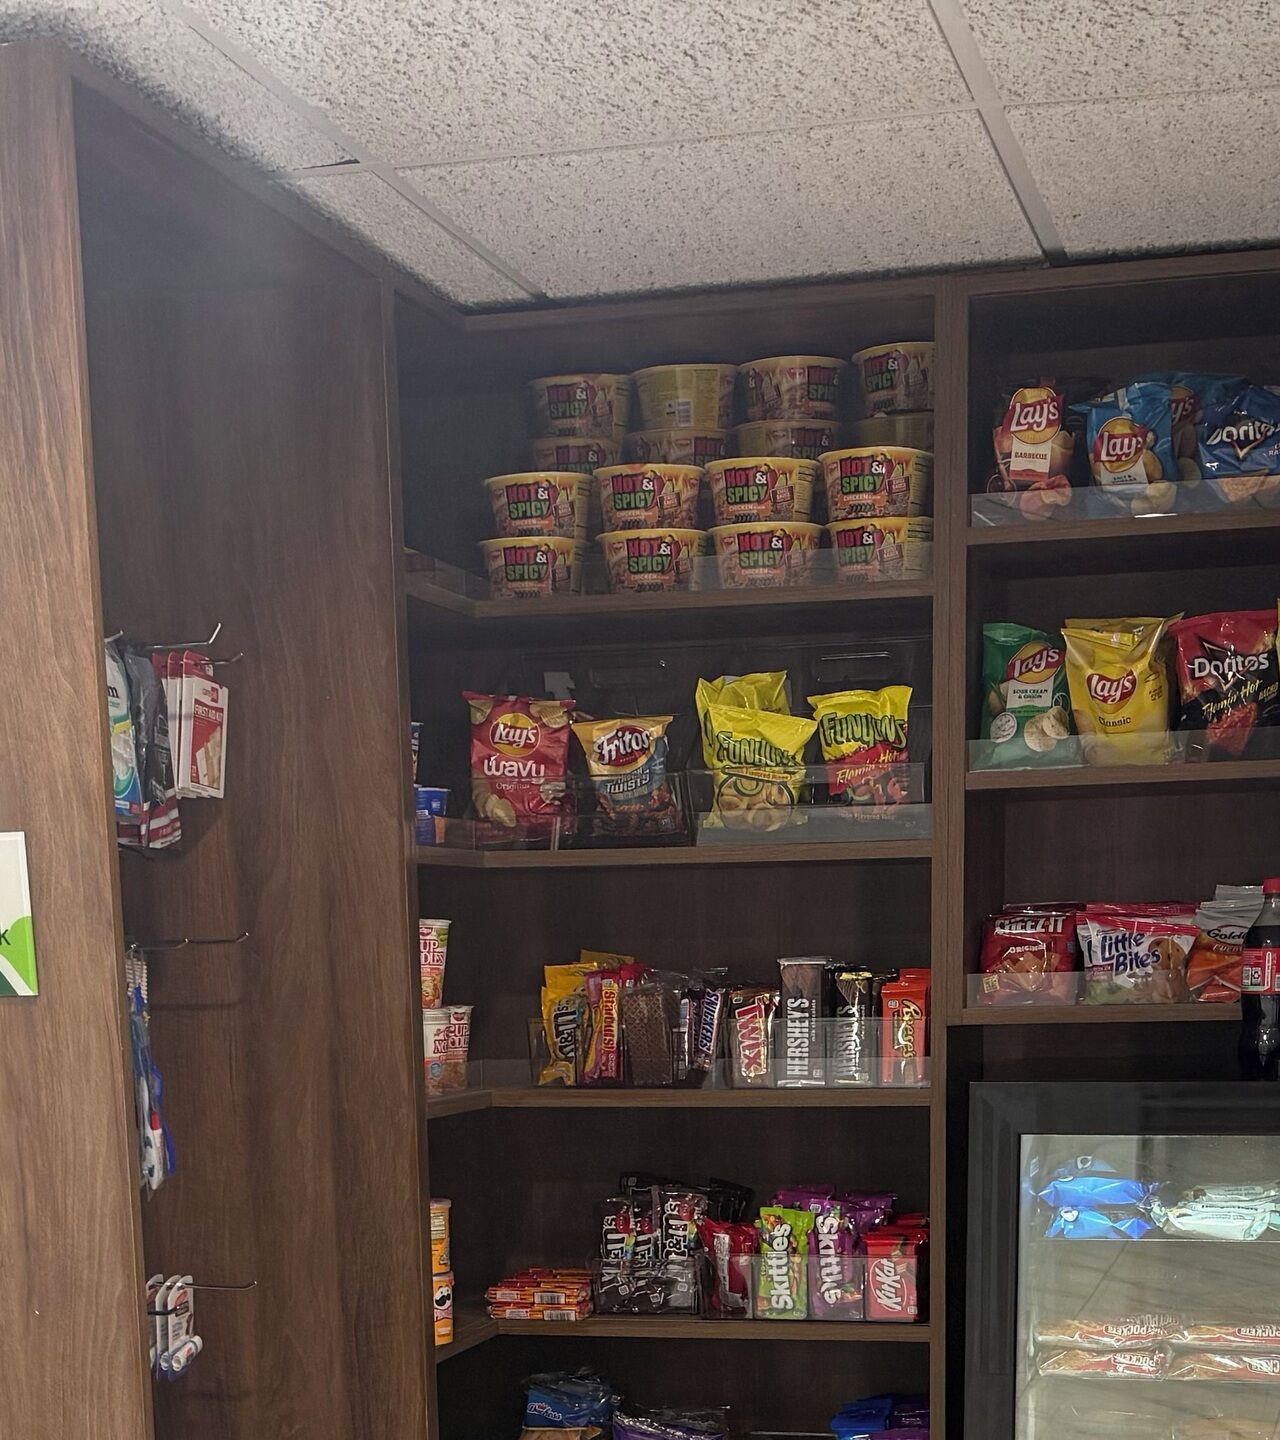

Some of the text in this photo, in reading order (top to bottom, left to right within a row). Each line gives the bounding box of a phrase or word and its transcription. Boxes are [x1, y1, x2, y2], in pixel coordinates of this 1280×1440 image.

[1011, 398, 1059, 432] Lay's
[840, 456, 872, 476] HOT
[612, 475, 641, 491] HOT
[724, 467, 755, 487] HOT
[843, 475, 882, 493] SPICY
[506, 484, 537, 501] HOT
[614, 492, 654, 509] SPICY
[727, 486, 766, 503] SPICY
[508, 502, 549, 518] SPICY
[628, 538, 660, 556] HOT
[738, 532, 771, 551] HOT
[836, 527, 863, 548] HOT
[629, 556, 671, 574] SPICY
[740, 551, 783, 568] SPICY
[838, 547, 873, 566] SPICY
[505, 565, 547, 581] SPICY
[1194, 652, 1270, 678] Doritos
[1091, 674, 1134, 704] Lay's
[494, 724, 537, 748] Lay's
[821, 712, 907, 748] FUNYUNS
[594, 729, 650, 764] Fritos
[1101, 933, 1146, 962] Little
[1114, 949, 1161, 975] Bites
[787, 998, 809, 1076] HERSHEY'S
[772, 1224, 792, 1309] Skittles
